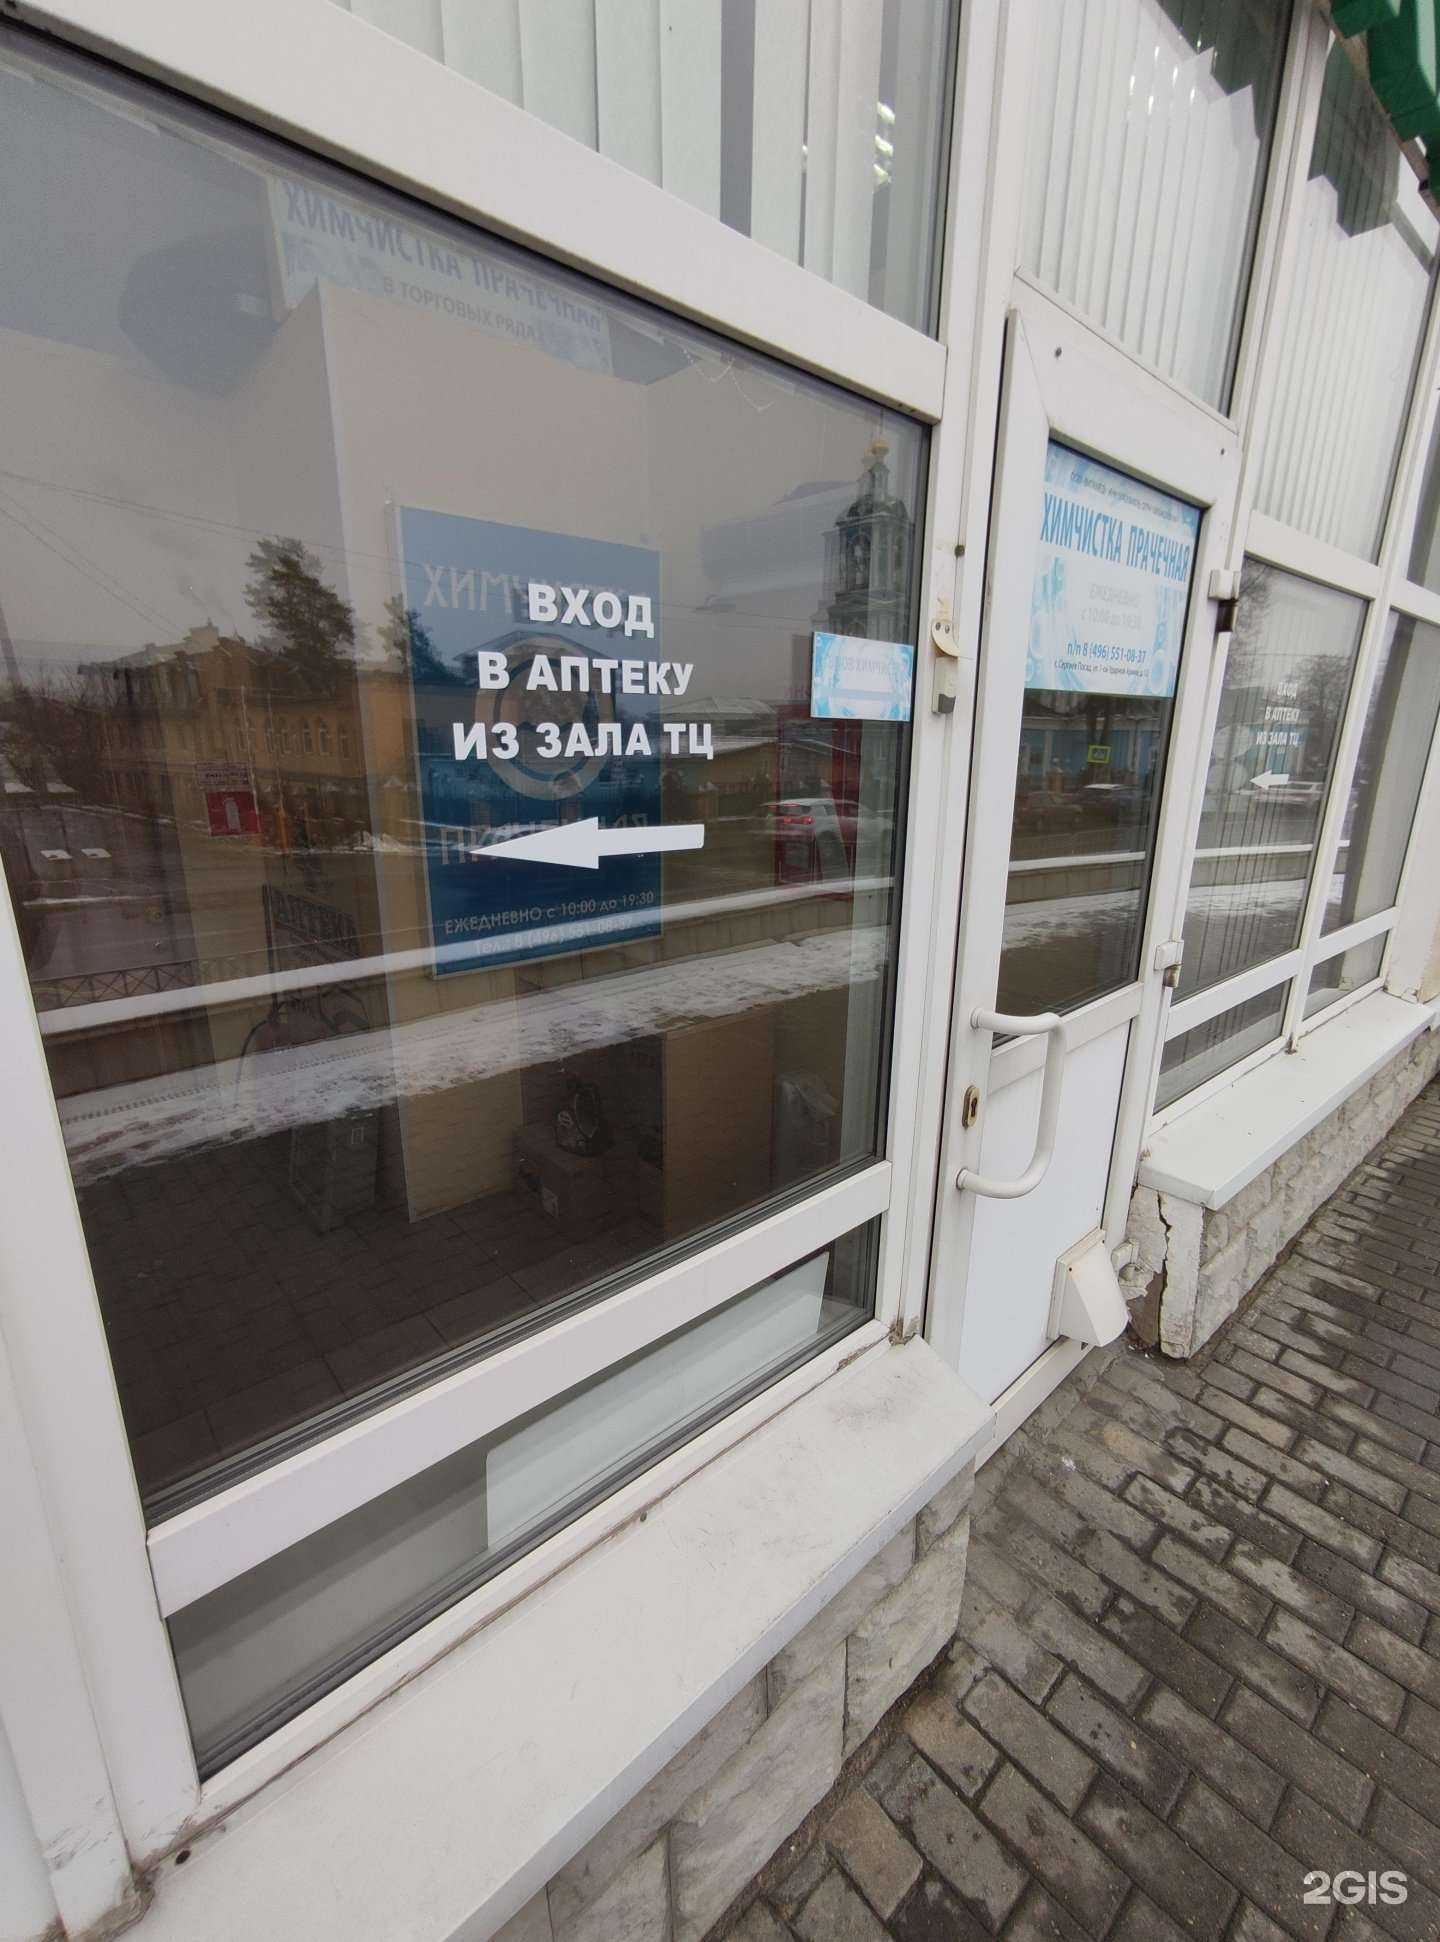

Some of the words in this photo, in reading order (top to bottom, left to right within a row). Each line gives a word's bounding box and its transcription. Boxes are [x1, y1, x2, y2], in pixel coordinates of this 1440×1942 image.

[1040, 491, 1123, 563] ХИМЧИСТКА
[1126, 525, 1191, 583] ПРАЧЕЧНАЯ
[528, 583, 655, 638] ВХОД
[477, 650, 510, 690] В
[526, 654, 694, 696] АПТЕКУ
[1110, 645, 1146, 664] 551-08-37
[452, 721, 520, 761] ИЗ
[536, 722, 652, 760] ЗАЛА
[663, 722, 714, 761] ТЦ
[445, 906, 543, 935] ЕЖЕДНЕВНО
[546, 908, 556, 919] с
[560, 898, 597, 917] 10:00
[621, 890, 655, 906] 19:30
